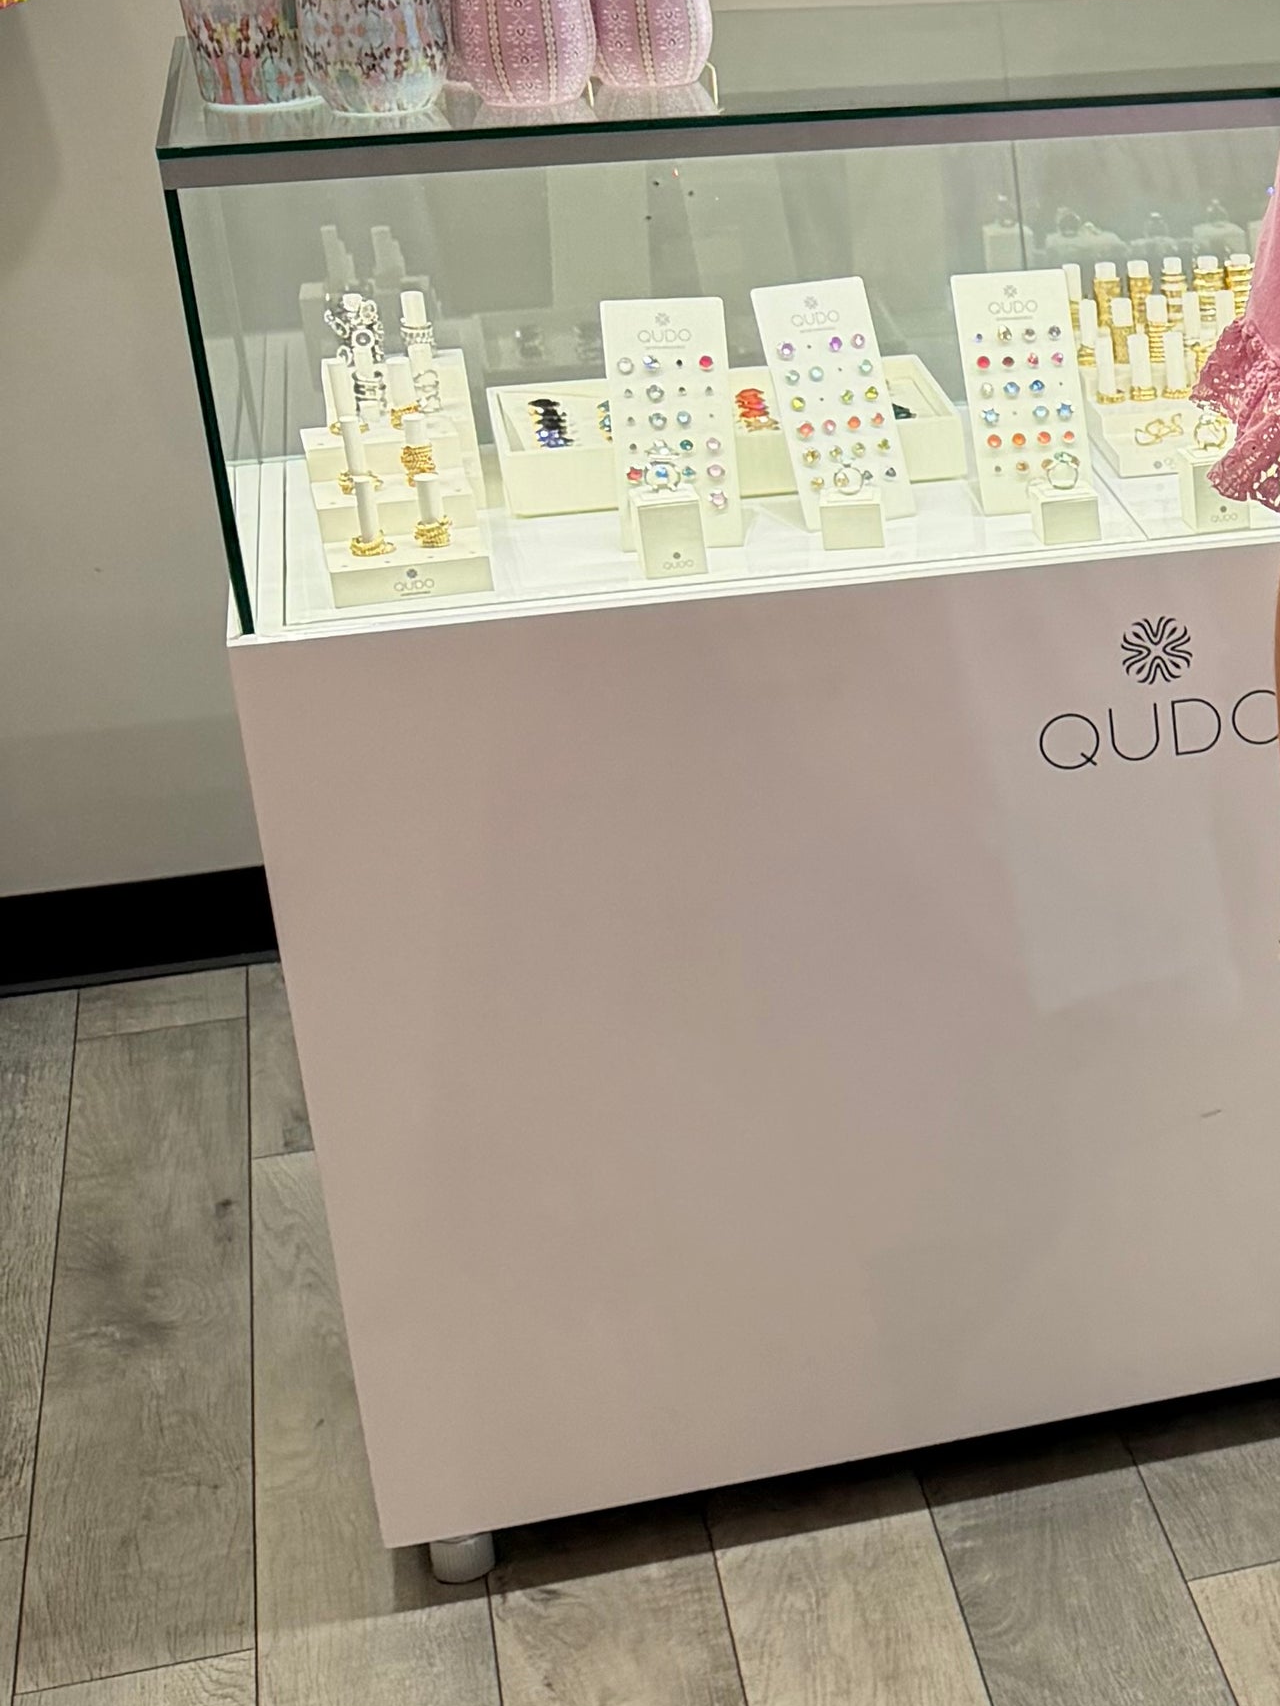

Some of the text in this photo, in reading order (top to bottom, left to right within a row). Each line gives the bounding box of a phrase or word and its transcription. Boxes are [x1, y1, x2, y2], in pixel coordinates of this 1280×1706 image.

[987, 299, 1038, 315] QUDO
[791, 309, 840, 327] QUDO
[637, 328, 692, 343] QUDO
[393, 578, 435, 592] QUDO
[1039, 689, 1279, 770] QUDO
